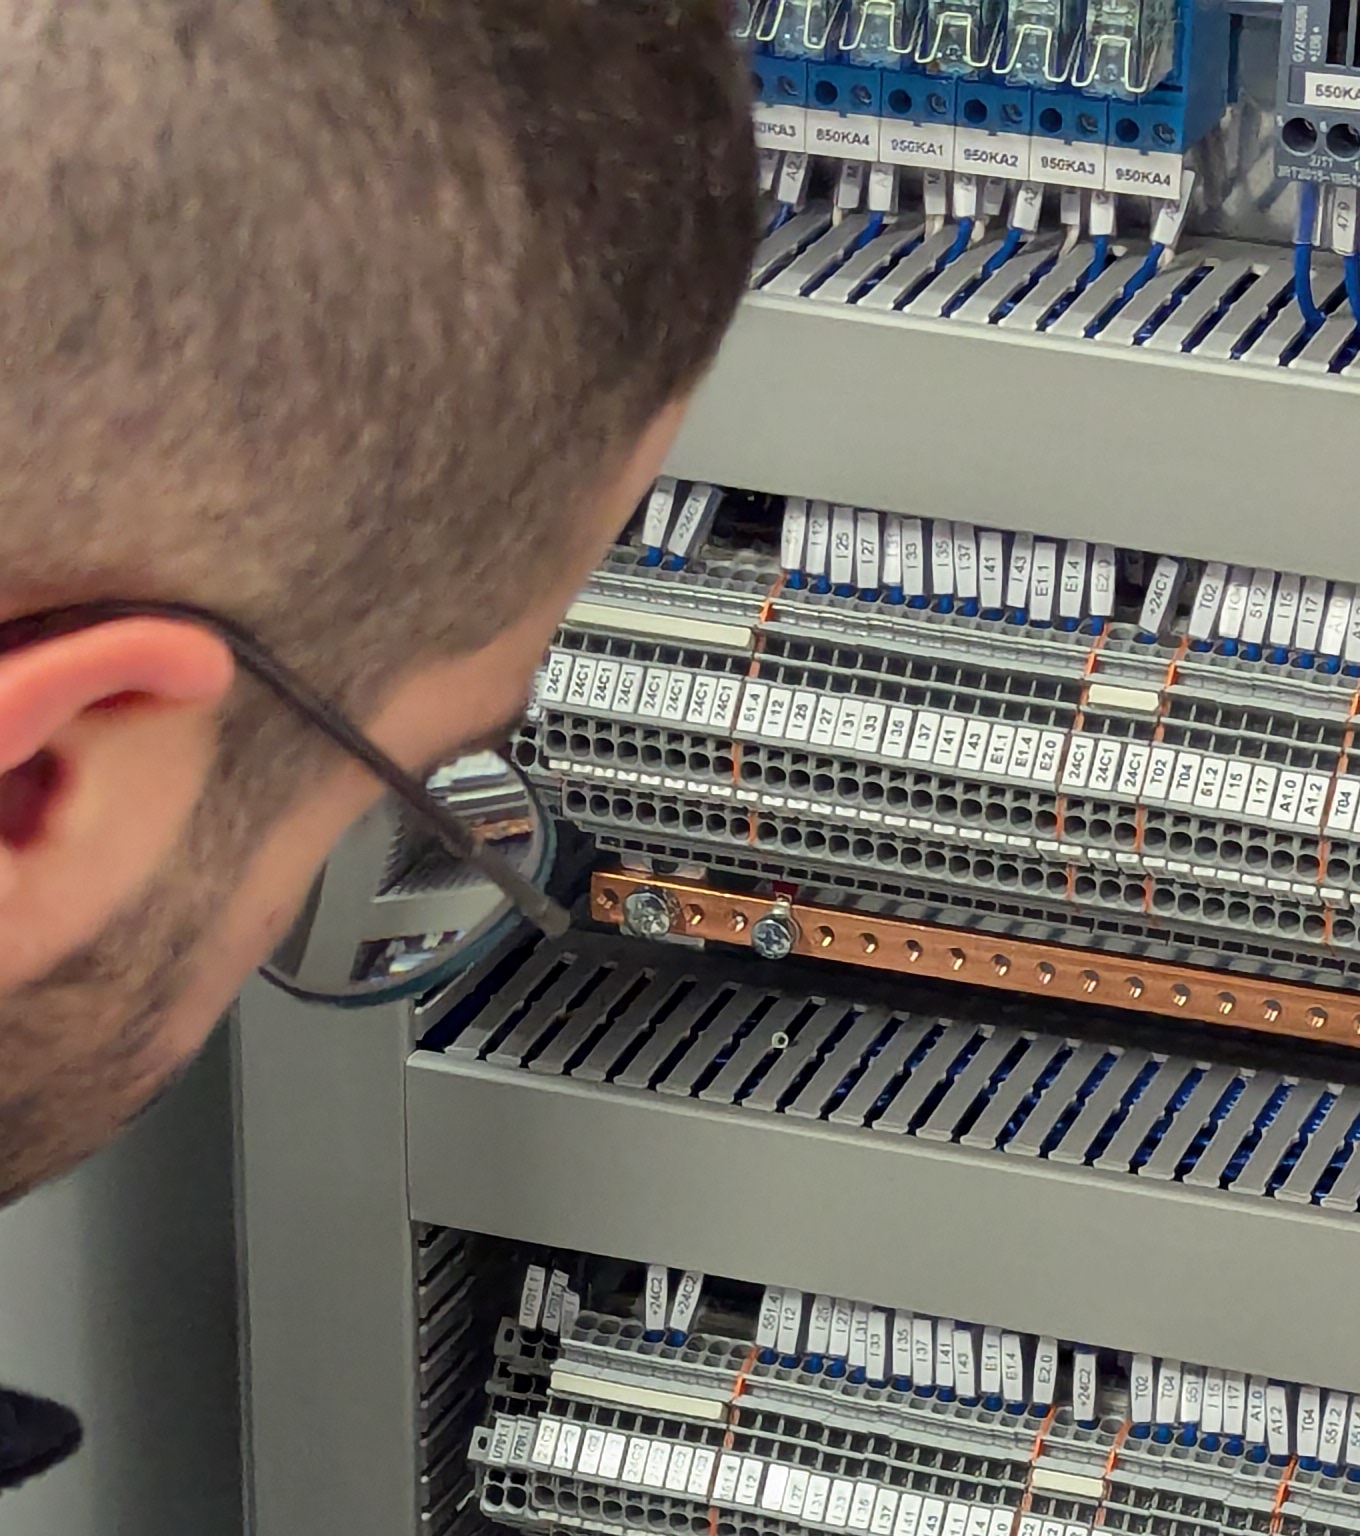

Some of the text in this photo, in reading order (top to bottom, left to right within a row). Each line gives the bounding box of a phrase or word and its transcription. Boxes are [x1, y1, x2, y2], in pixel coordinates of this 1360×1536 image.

[816, 128, 870, 145] 850KA4
[891, 139, 943, 156] 950KA1
[964, 148, 1018, 167] 950KA2
[1041, 156, 1095, 174] 950KA3
[1116, 168, 1170, 185] 950KA4
[1149, 572, 1172, 615] +24C1
[1199, 584, 1218, 610] T02
[547, 659, 565, 694] 24C1
[572, 663, 590, 699] 24C1
[594, 667, 612, 702] 24C1
[618, 670, 636, 705] 24C1
[644, 674, 662, 710] 24C1
[666, 678, 685, 713] 24C1
[692, 681, 710, 717] 24C1
[715, 685, 732, 720] 24C1
[990, 734, 1007, 764] E1.1
[1015, 737, 1033, 767] E1.4
[1039, 740, 1057, 771] E2.0
[1069, 743, 1088, 779] 24C1
[1096, 748, 1114, 783] 24C1
[1124, 752, 1143, 787] 24C1
[1150, 759, 1168, 785] T02
[1175, 764, 1193, 789] T04
[1279, 779, 1297, 812] A1.0
[1304, 783, 1322, 816] A1.2
[1335, 791, 1352, 816] T04
[650, 1277, 663, 1316] +24C2
[679, 1276, 698, 1316] +24C2
[1038, 1355, 1052, 1384] E2.0
[1135, 1375, 1149, 1400] T02
[1161, 1376, 1175, 1399] T04
[1301, 1408, 1315, 1432] T04
